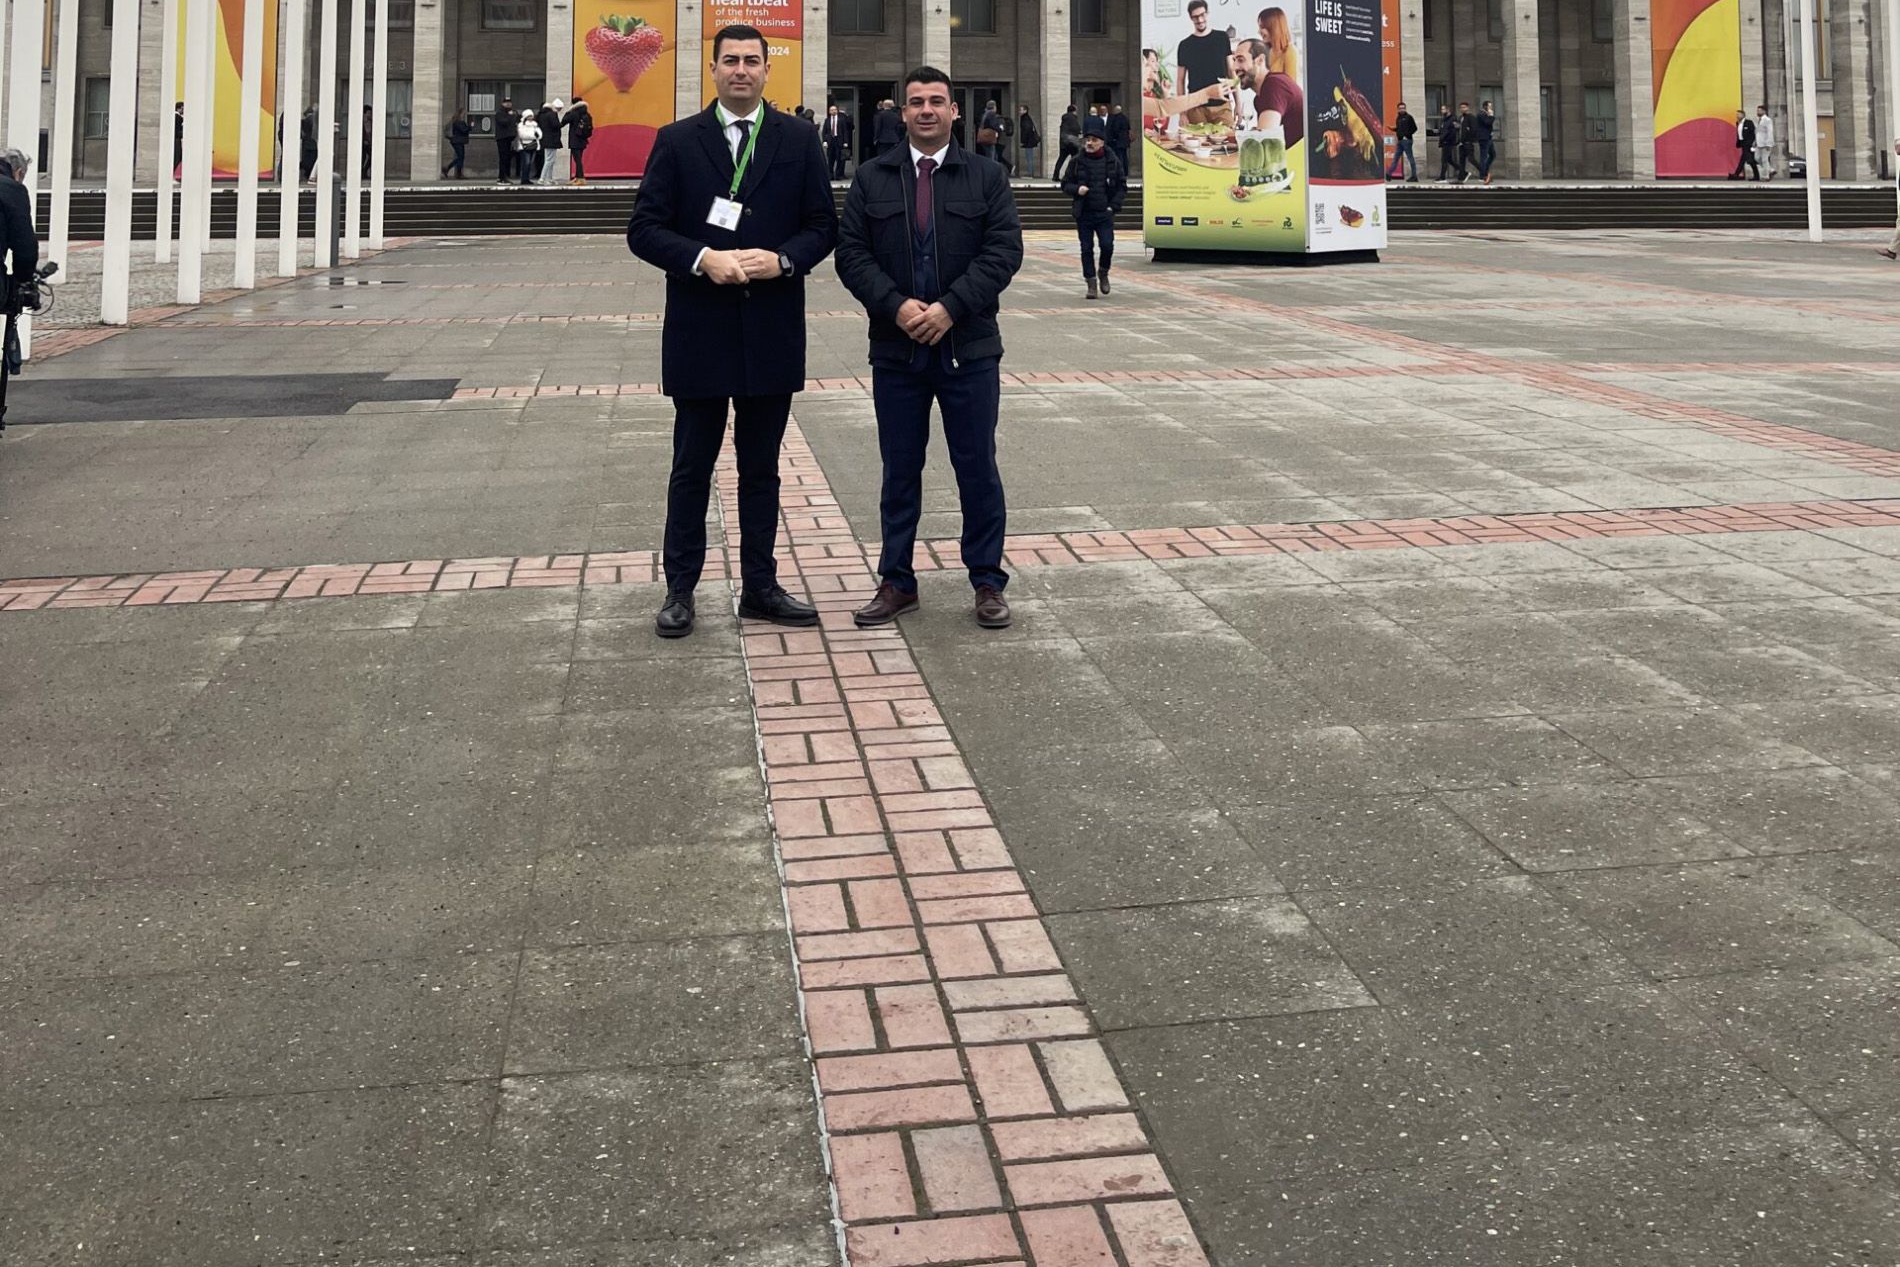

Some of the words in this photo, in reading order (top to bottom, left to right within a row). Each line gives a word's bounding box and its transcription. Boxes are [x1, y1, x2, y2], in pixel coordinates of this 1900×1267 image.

[715, 7, 725, 16] of
[728, 7, 743, 16] the
[746, 7, 769, 16] fresh
[1315, 0, 1333, 16] LIFE
[1334, 2, 1342, 17] IS
[715, 18, 753, 27] produce
[756, 18, 796, 27] business
[1315, 17, 1343, 34] SWEET
